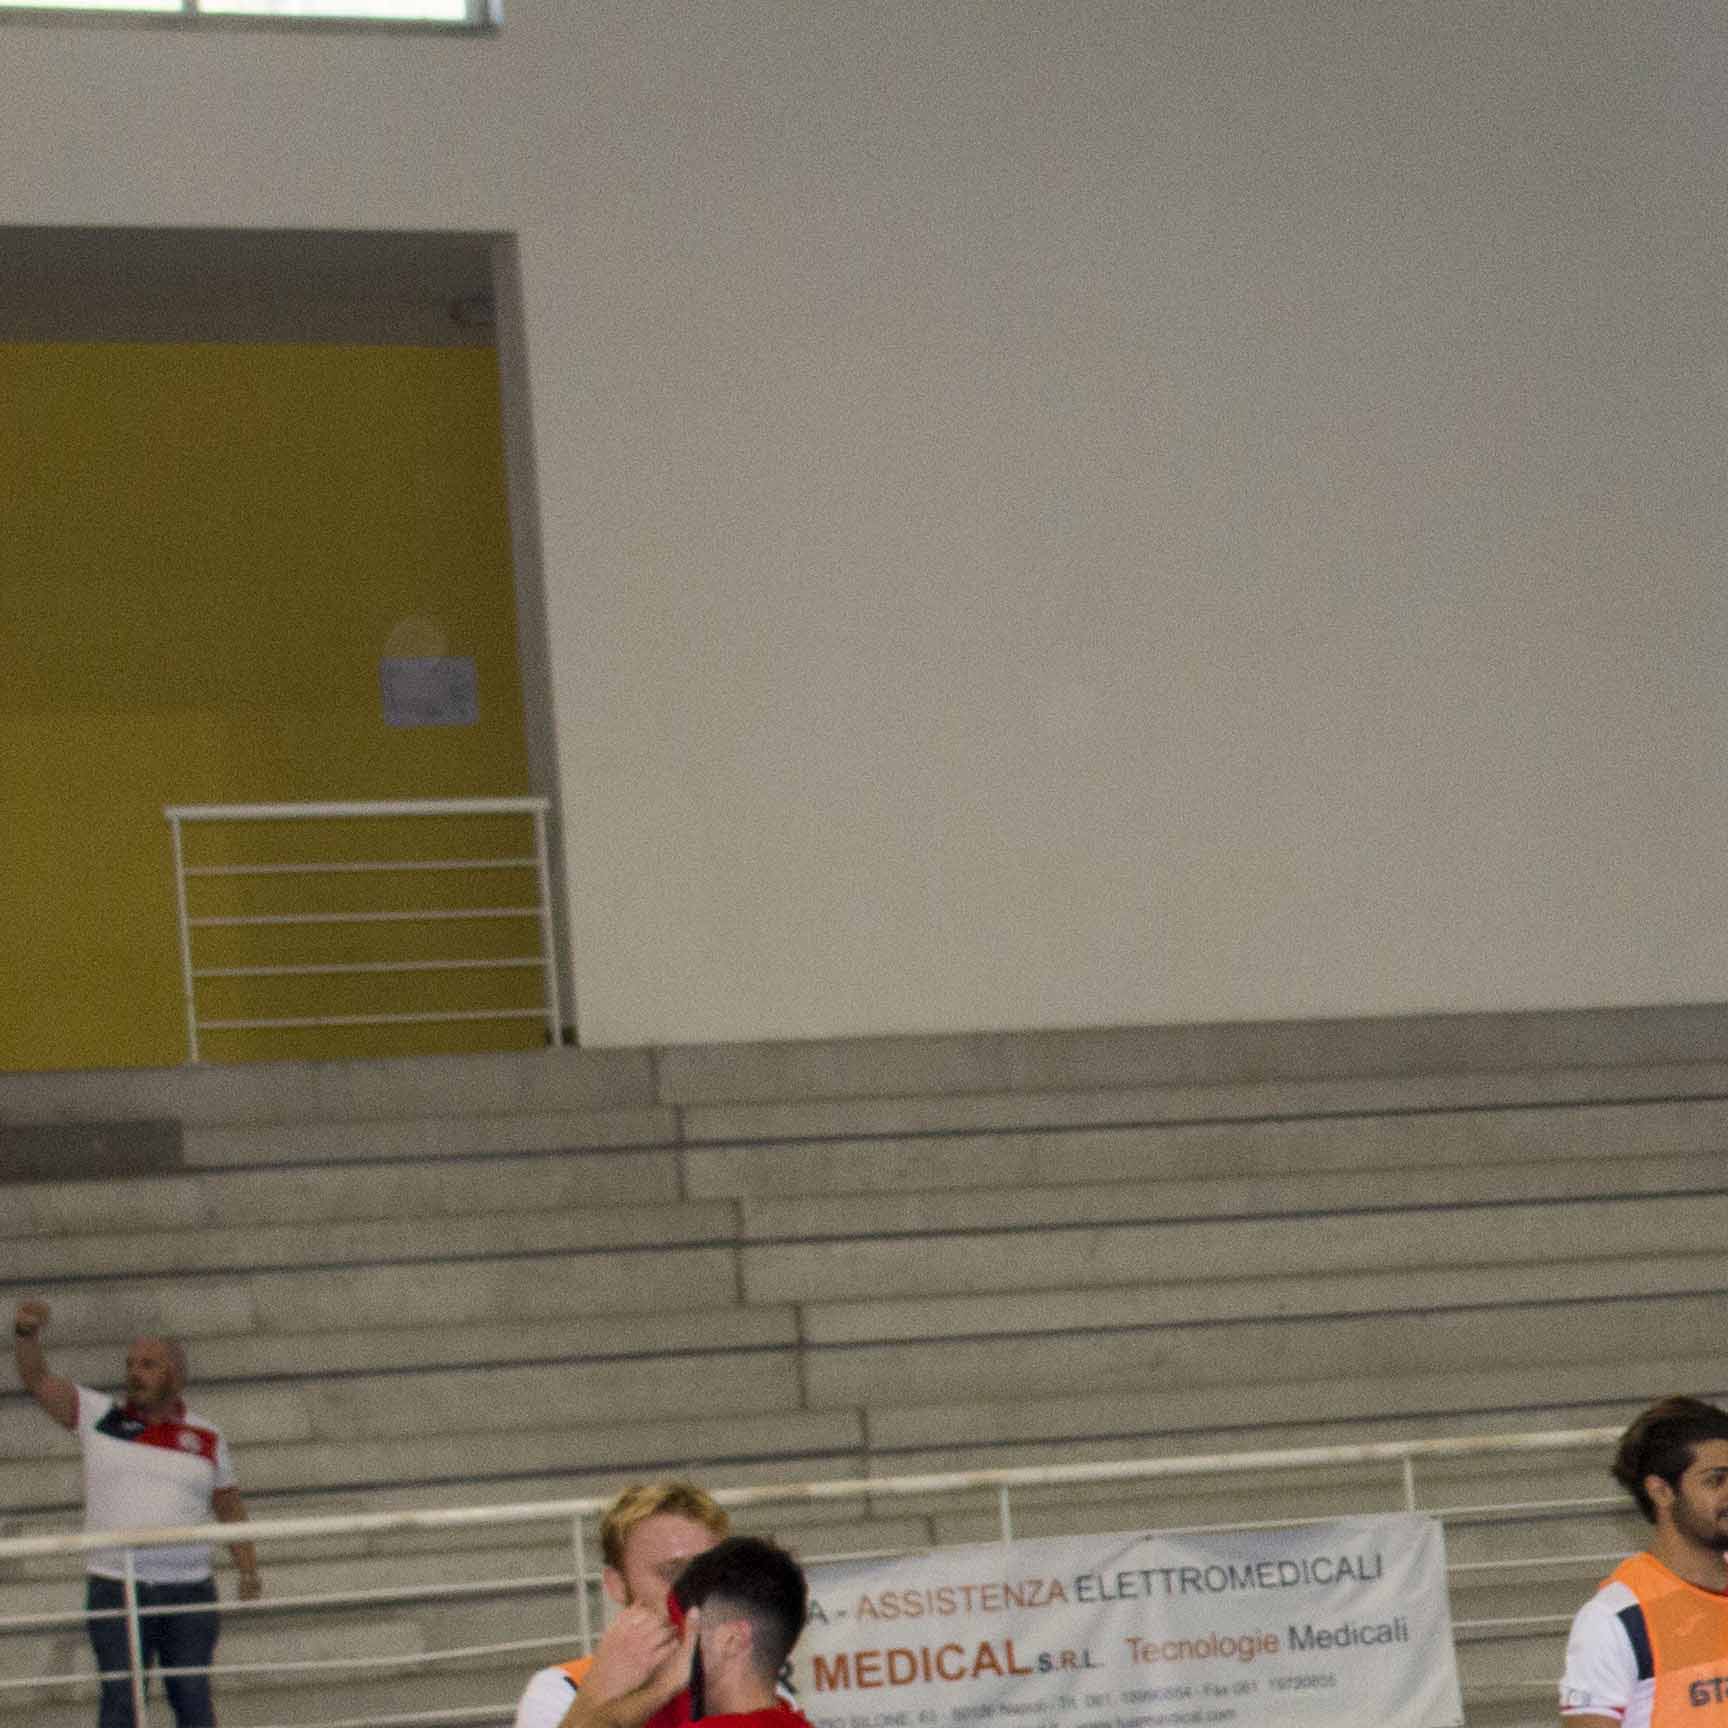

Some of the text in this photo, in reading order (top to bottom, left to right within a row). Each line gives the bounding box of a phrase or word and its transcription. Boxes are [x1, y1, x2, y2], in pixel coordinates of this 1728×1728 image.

[856, 1576, 1068, 1621] ASSISTENZA
[1074, 1553, 1383, 1602] ELETTROMEDICALI
[812, 1638, 1032, 1693] MEDICAL
[1124, 1630, 1281, 1664] Tecnologie
[1286, 1616, 1409, 1651] Medicali
